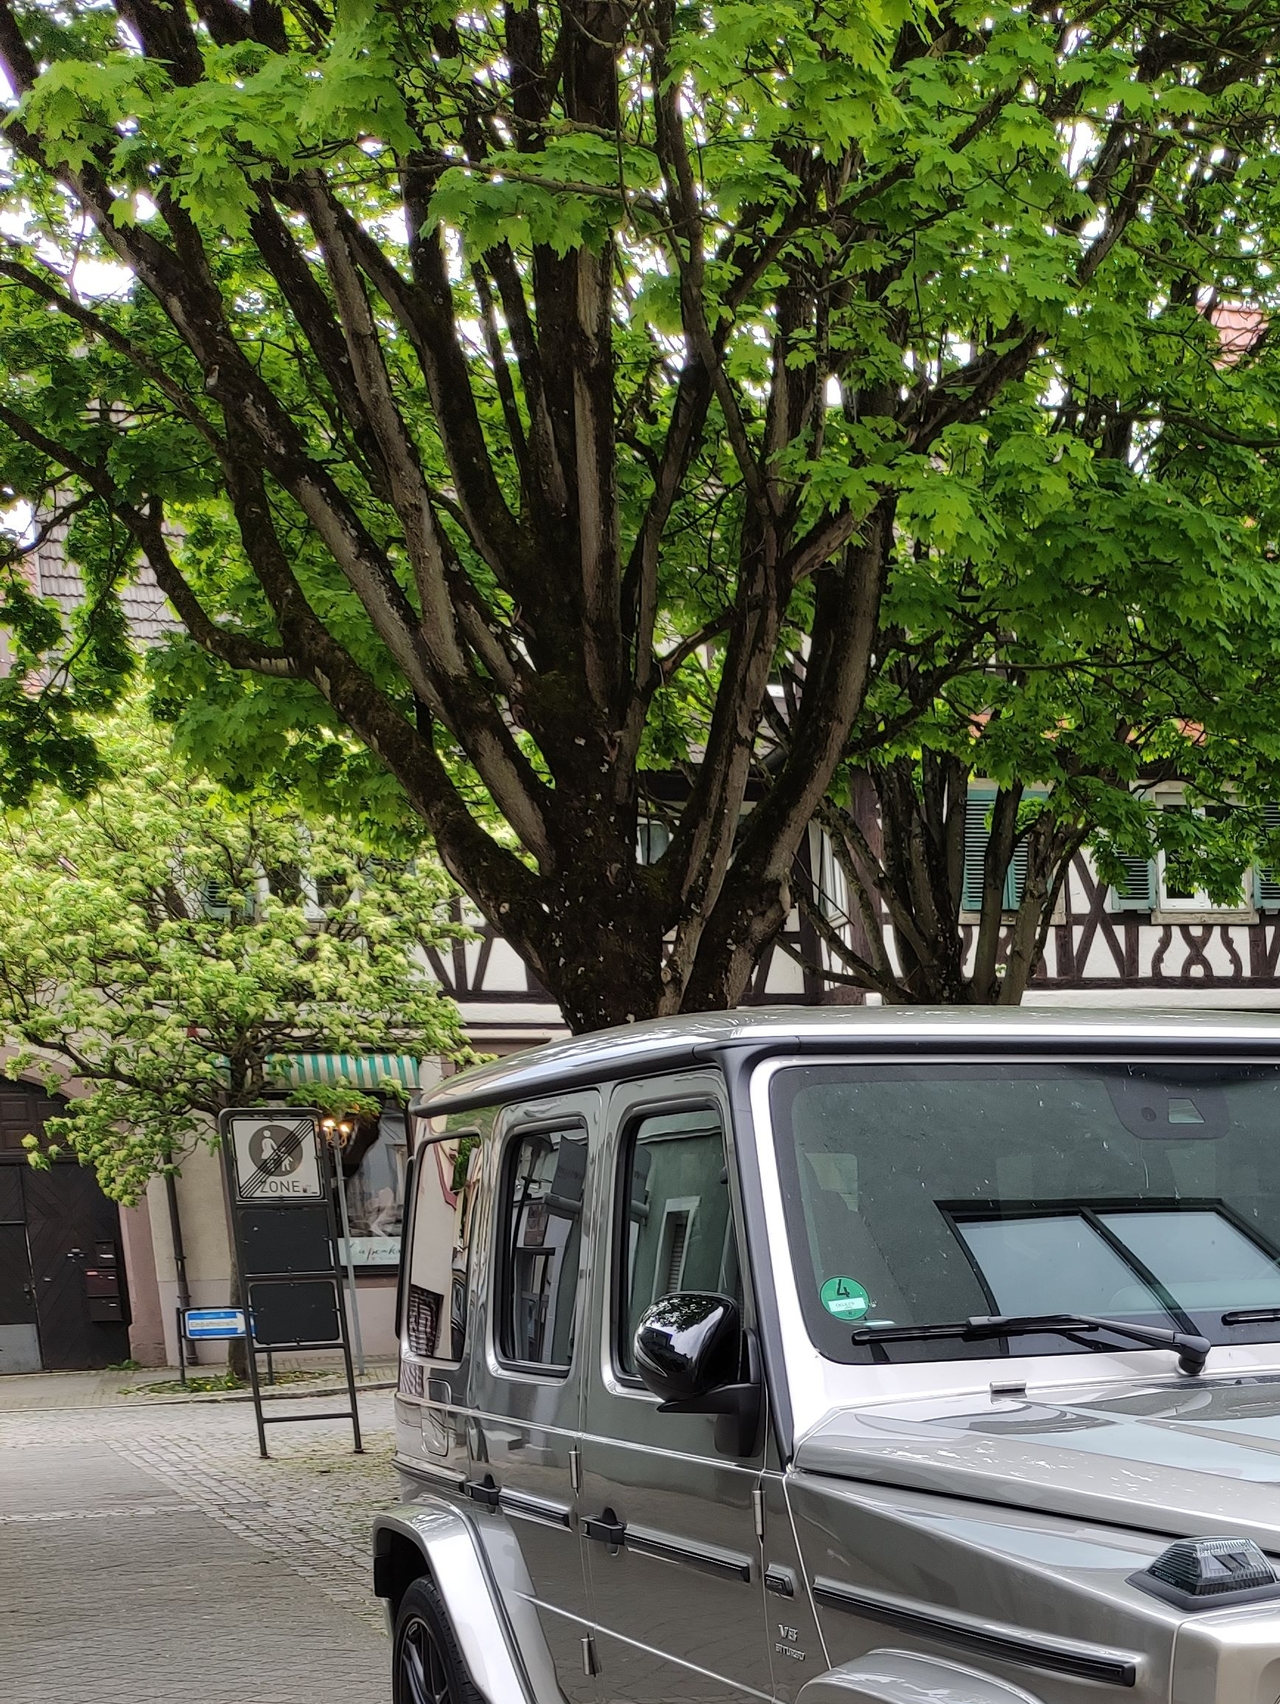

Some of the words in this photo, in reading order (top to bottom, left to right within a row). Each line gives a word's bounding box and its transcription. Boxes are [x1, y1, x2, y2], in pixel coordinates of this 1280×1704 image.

[259, 1180, 301, 1193] ZONE
[837, 1278, 850, 1298] 4
[778, 1624, 798, 1641] V8
